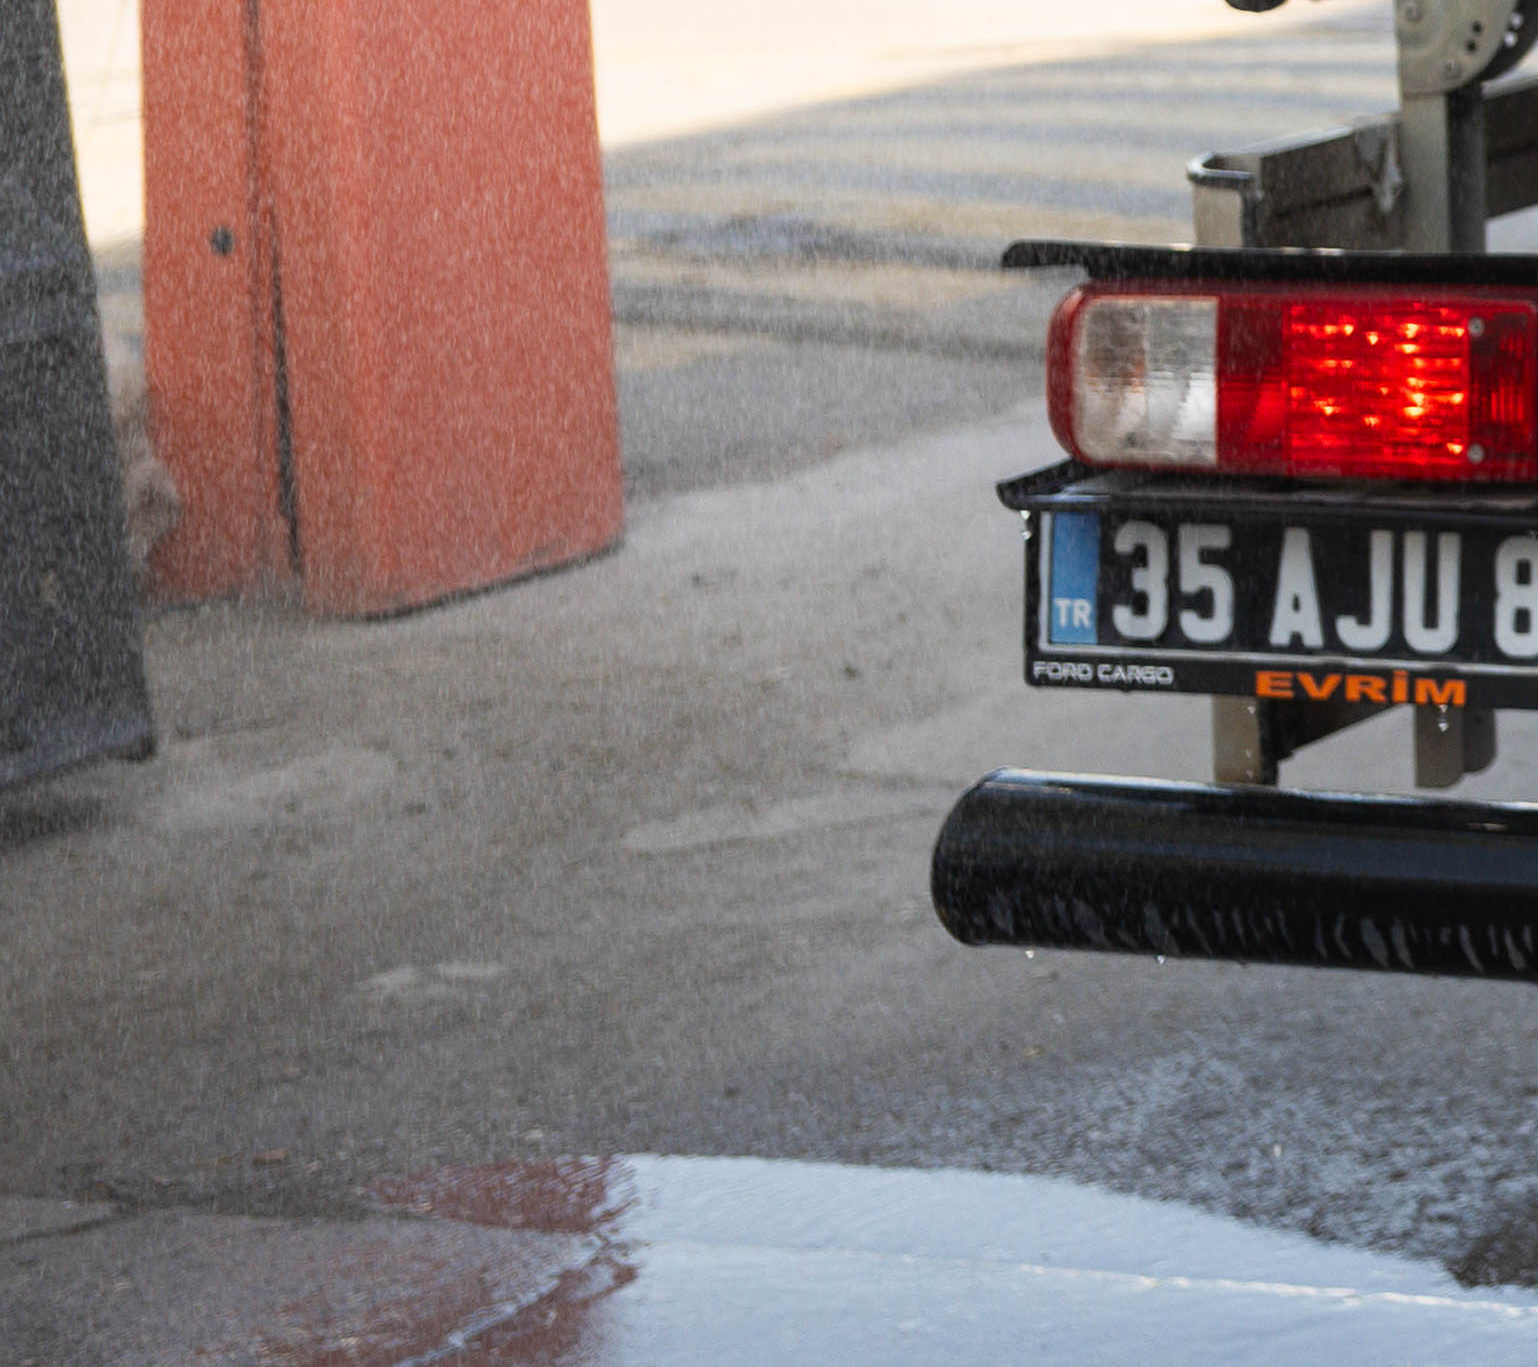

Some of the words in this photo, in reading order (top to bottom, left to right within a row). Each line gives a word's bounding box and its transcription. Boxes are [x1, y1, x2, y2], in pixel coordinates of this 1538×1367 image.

[1110, 520, 1235, 645] 35
[1268, 527, 1462, 655] AJU
[1055, 598, 1092, 630] TR
[1033, 662, 1093, 682] FORD
[1097, 665, 1174, 685] CARGO
